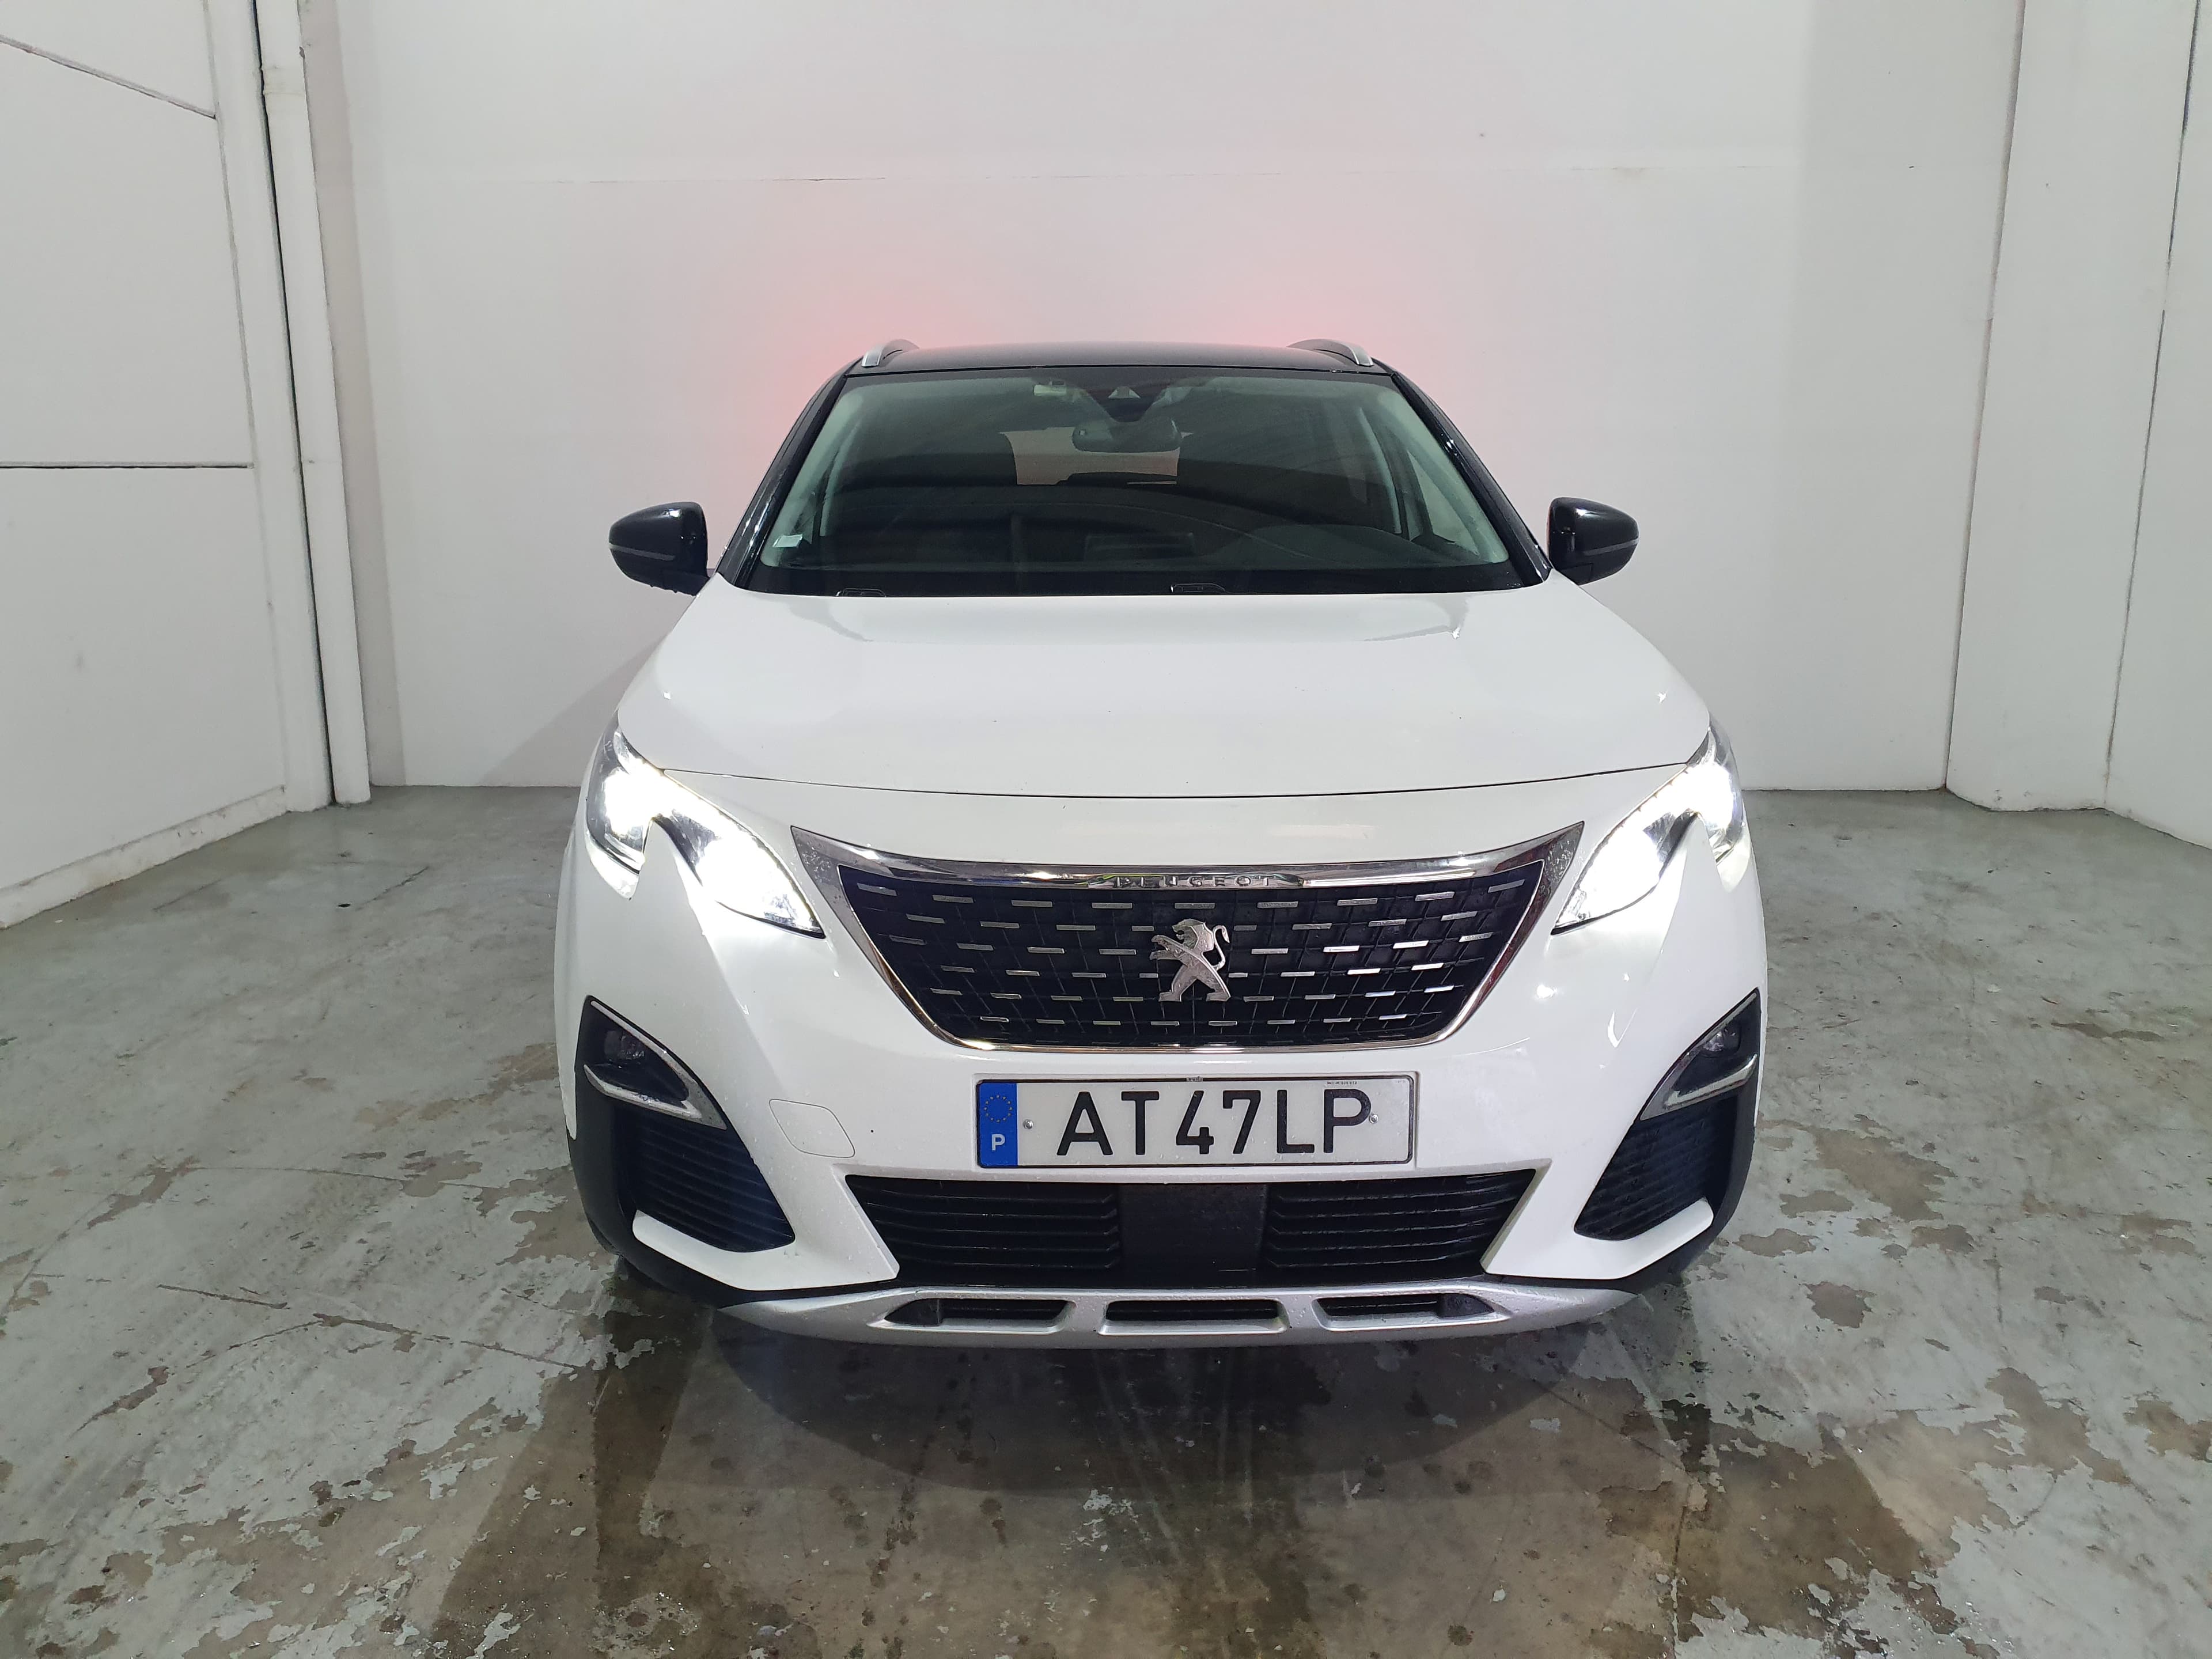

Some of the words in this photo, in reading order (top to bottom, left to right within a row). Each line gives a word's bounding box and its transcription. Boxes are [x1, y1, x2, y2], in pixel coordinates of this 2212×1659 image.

[1115, 875, 1278, 888] PEUGEOT
[1056, 1089, 1371, 1156] AT47LP
[991, 1134, 1006, 1151] P
